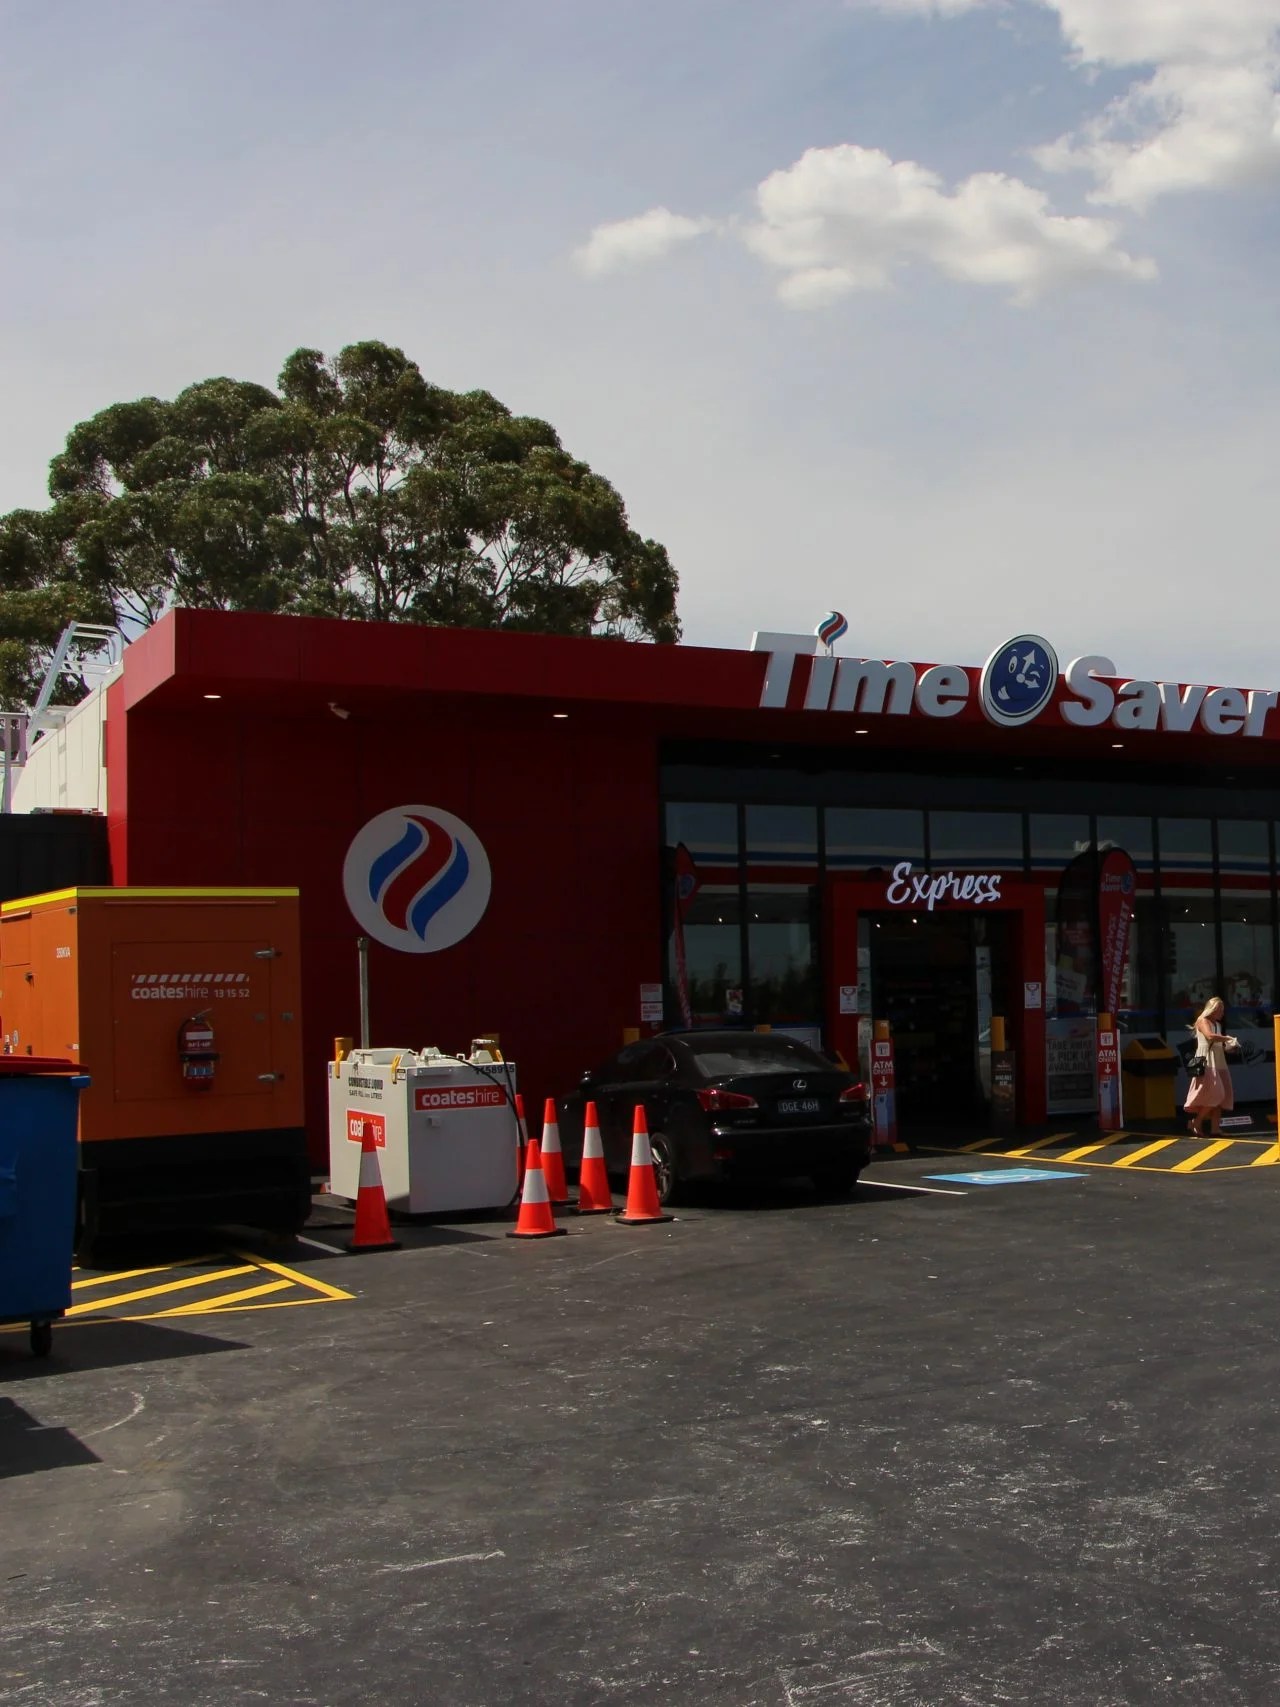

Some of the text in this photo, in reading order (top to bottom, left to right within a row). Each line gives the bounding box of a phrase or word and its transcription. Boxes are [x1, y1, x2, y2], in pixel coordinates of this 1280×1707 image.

[750, 611, 1278, 737] Time Saver
[1104, 873, 1121, 883] Time
[886, 861, 1002, 911] Express
[1106, 900, 1131, 1014] SUPERMARKET
[214, 989, 224, 998] 13
[1048, 1040, 1067, 1049] TAKE
[1057, 1050, 1078, 1061] PICK
[1098, 1049, 1117, 1057] ATM
[873, 1060, 894, 1069] ATM
[421, 1089, 500, 1107] coateshire
